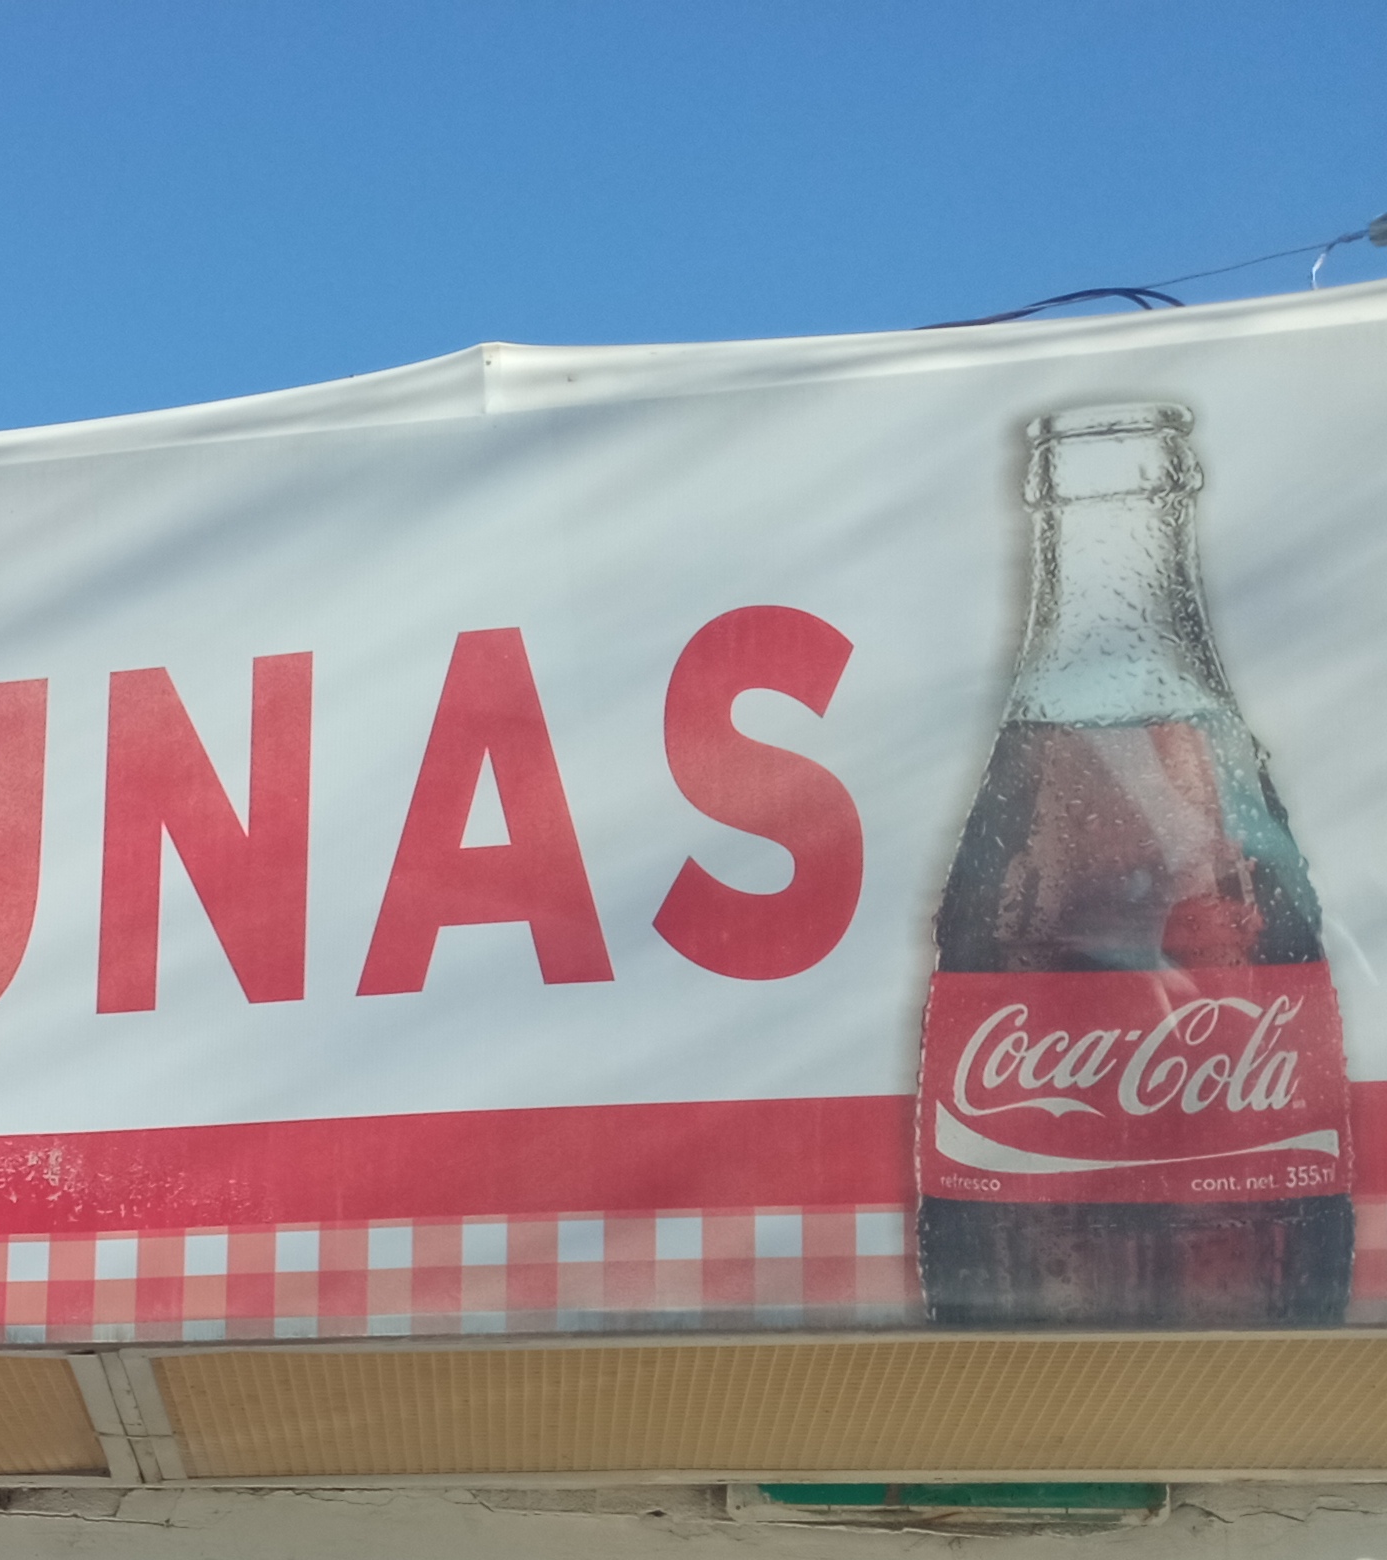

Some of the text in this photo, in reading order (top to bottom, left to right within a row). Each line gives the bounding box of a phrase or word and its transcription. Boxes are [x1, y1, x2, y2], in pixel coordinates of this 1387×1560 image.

[953, 995, 1304, 1117] Coca-Cola
[940, 1173, 1001, 1191] refresco
[1191, 1176, 1241, 1190] cont.
